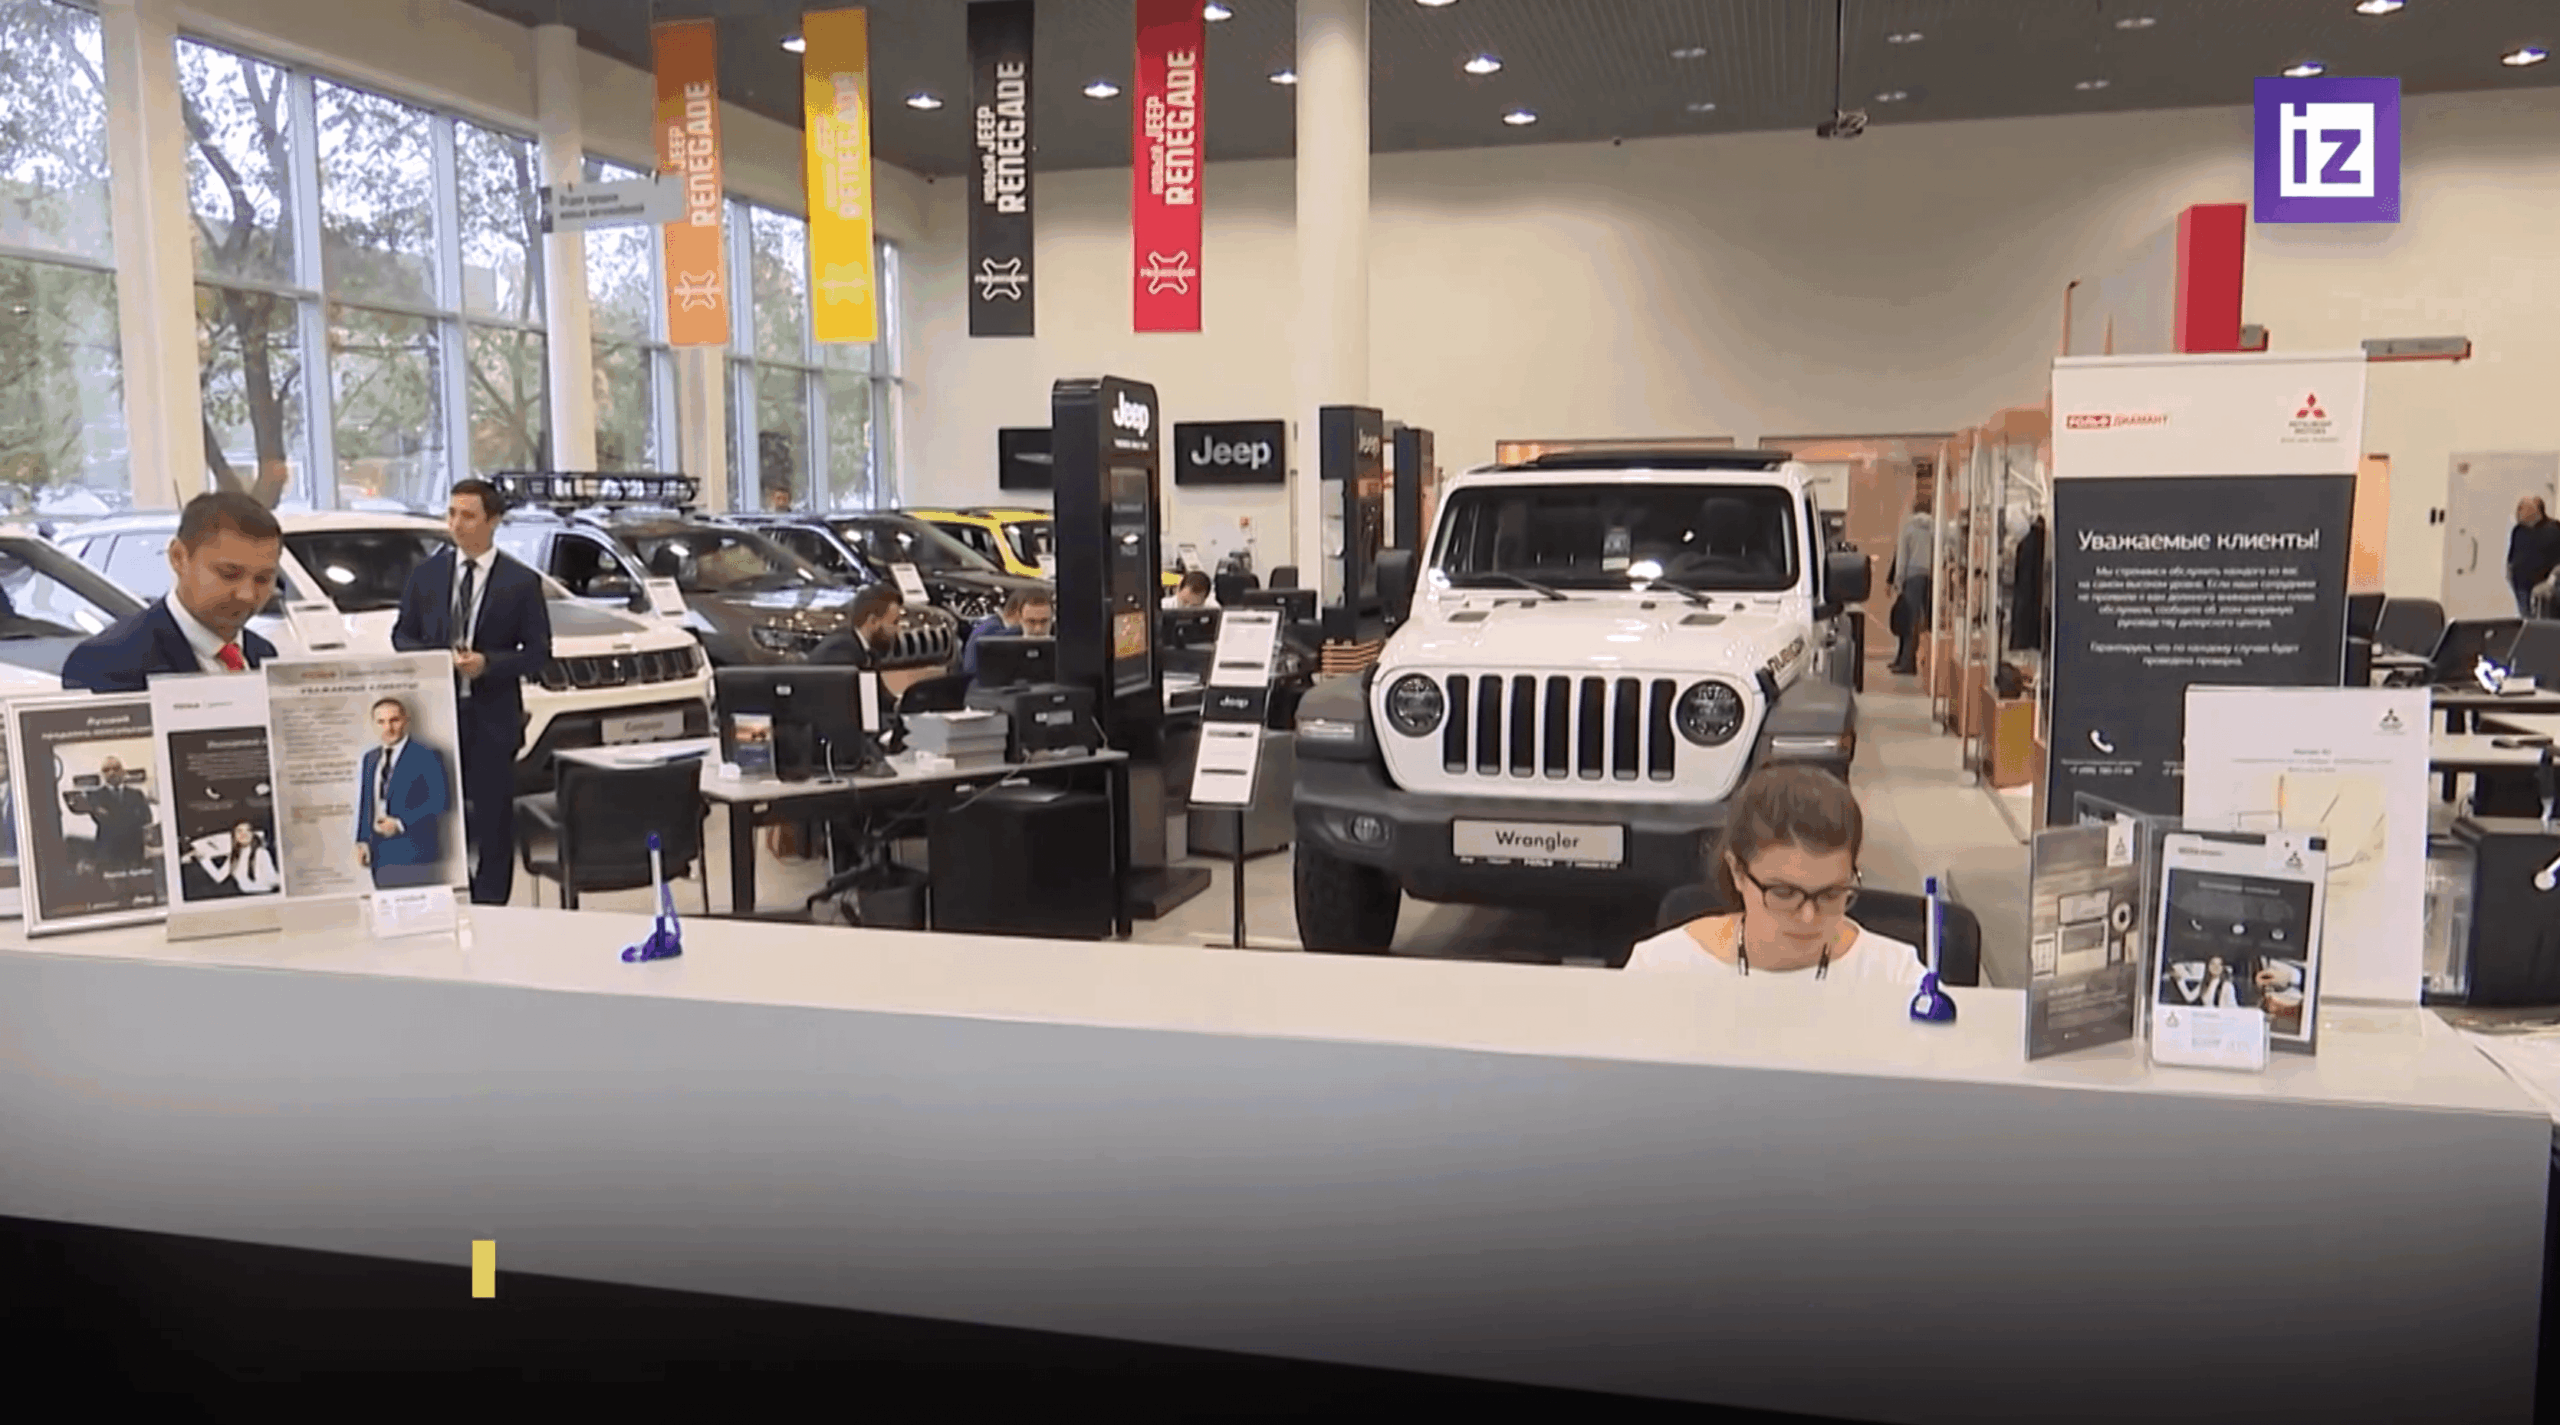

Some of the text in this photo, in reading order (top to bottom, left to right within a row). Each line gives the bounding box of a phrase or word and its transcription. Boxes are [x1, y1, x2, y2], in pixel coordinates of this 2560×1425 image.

[977, 105, 996, 152] JEEP
[997, 61, 1026, 213] RENEGADE
[1145, 96, 1165, 142] JEEP
[1165, 50, 1196, 205] RENEGADE
[684, 81, 718, 227] RENEGADE
[1112, 390, 1150, 437] Jeep
[1191, 435, 1273, 470] Jeep
[2078, 528, 2320, 550] Уважаемые клиенты!
[1494, 829, 1580, 853] Wrangler
